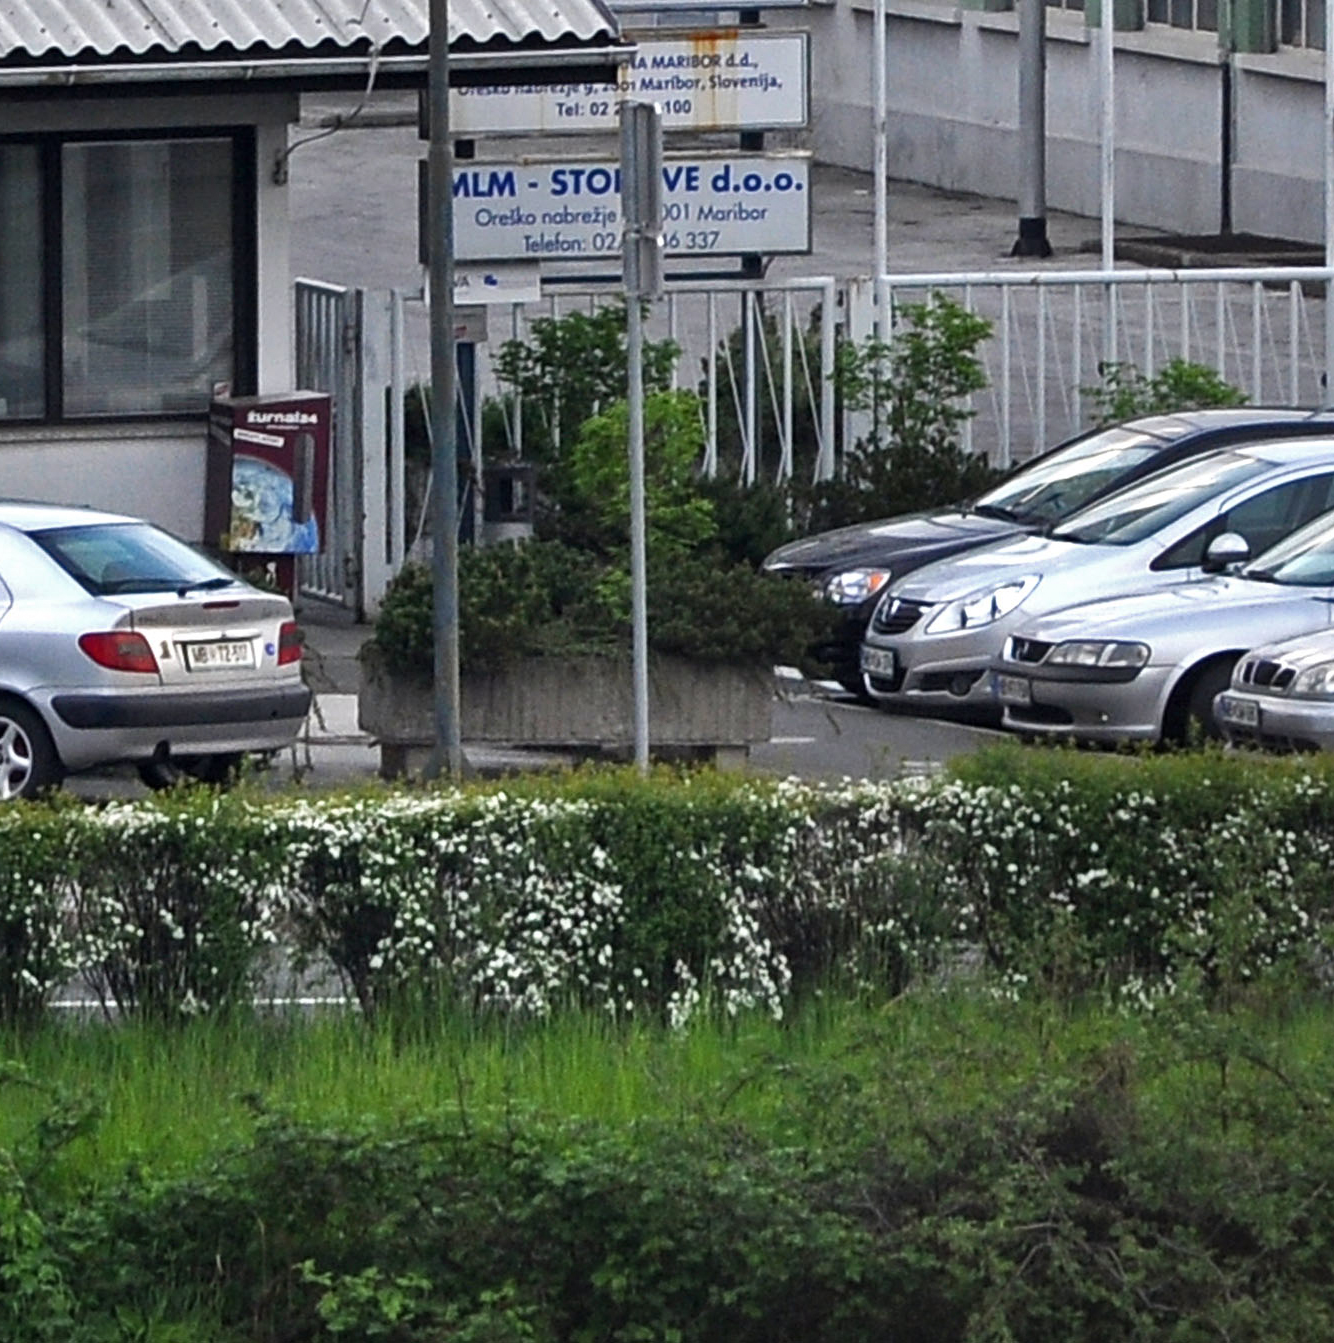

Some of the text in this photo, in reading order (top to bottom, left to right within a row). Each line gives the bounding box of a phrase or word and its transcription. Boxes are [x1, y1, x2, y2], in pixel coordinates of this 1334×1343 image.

[651, 54, 722, 69] MARIBOR
[640, 75, 707, 92] Maribor,
[709, 72, 784, 92] Slovenija,
[556, 102, 585, 116] Tel:
[589, 101, 609, 116] 02
[452, 170, 517, 198] MLM
[711, 163, 804, 193] d.o.o.
[474, 206, 537, 228] Oreško
[541, 204, 617, 229] nabrežje
[696, 201, 768, 222] Maribor
[686, 230, 721, 250] 337
